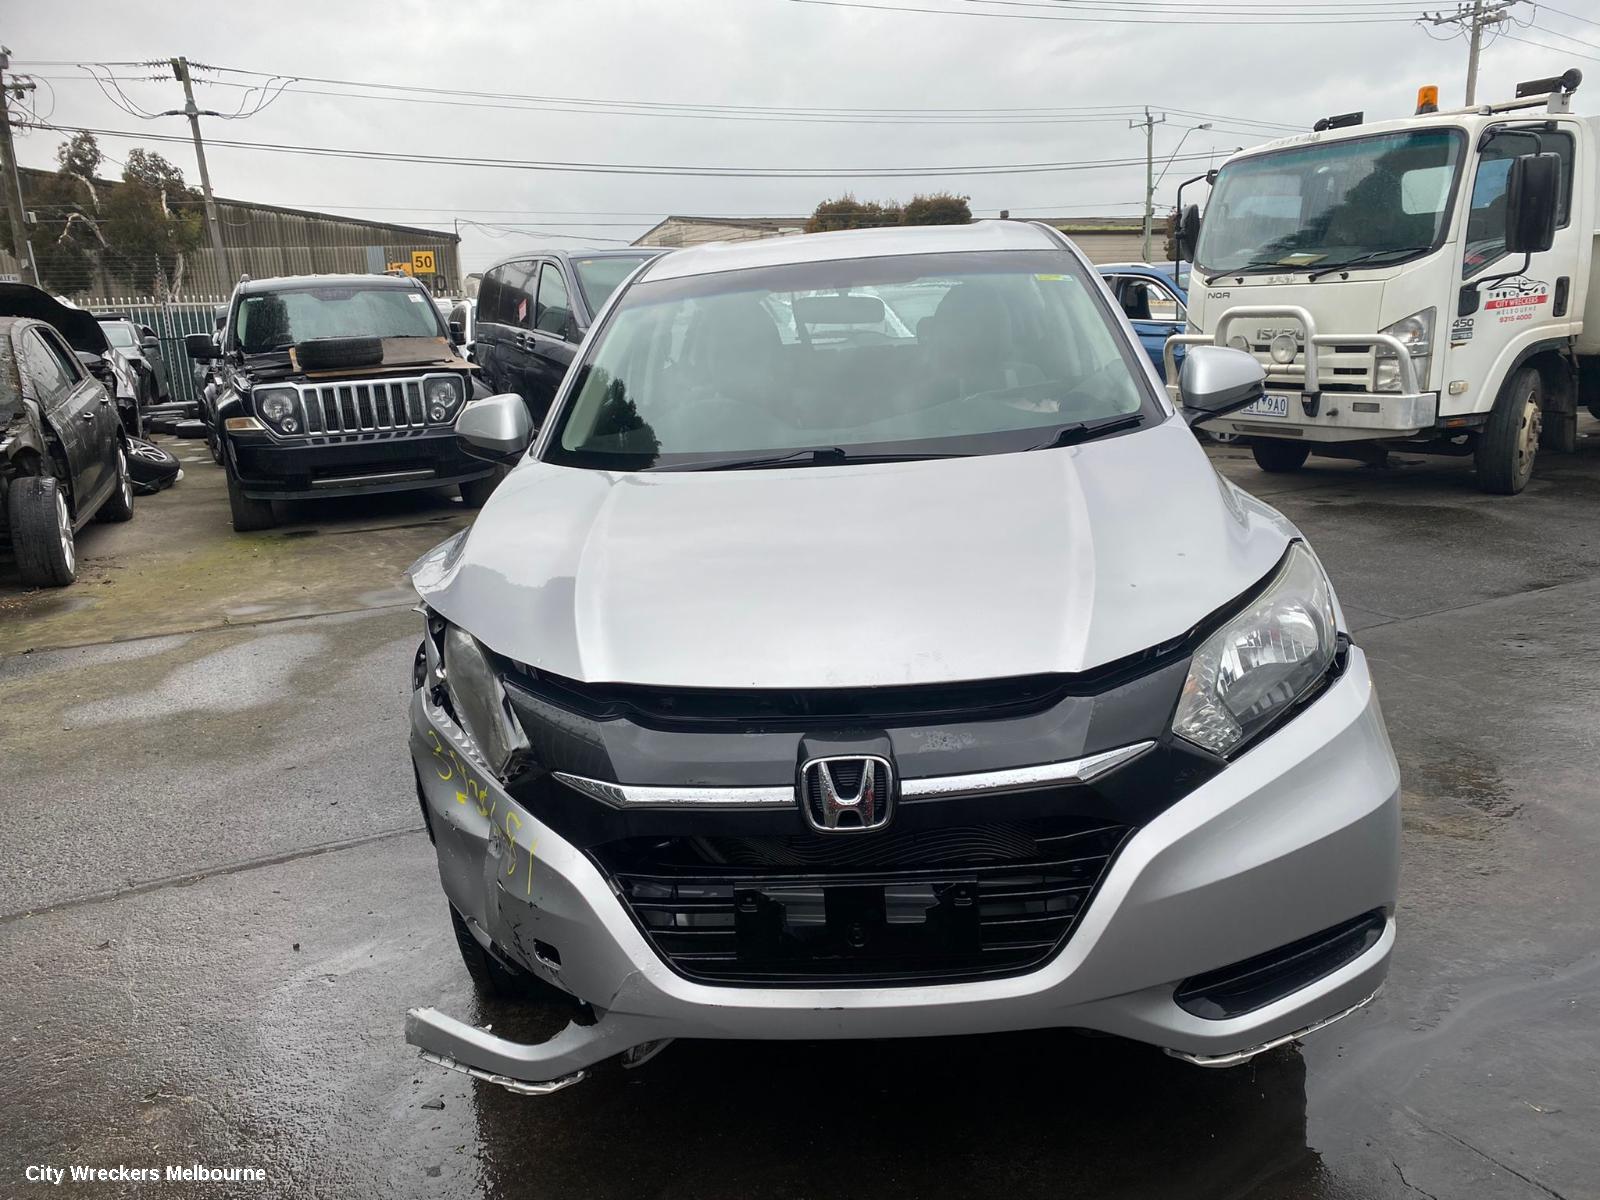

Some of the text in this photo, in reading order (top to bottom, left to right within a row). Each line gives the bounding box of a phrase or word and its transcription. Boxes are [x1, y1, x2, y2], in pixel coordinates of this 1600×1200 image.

[415, 255, 433, 268] 50
[1495, 300, 1508, 308] CITY
[1452, 318, 1475, 328] 450
